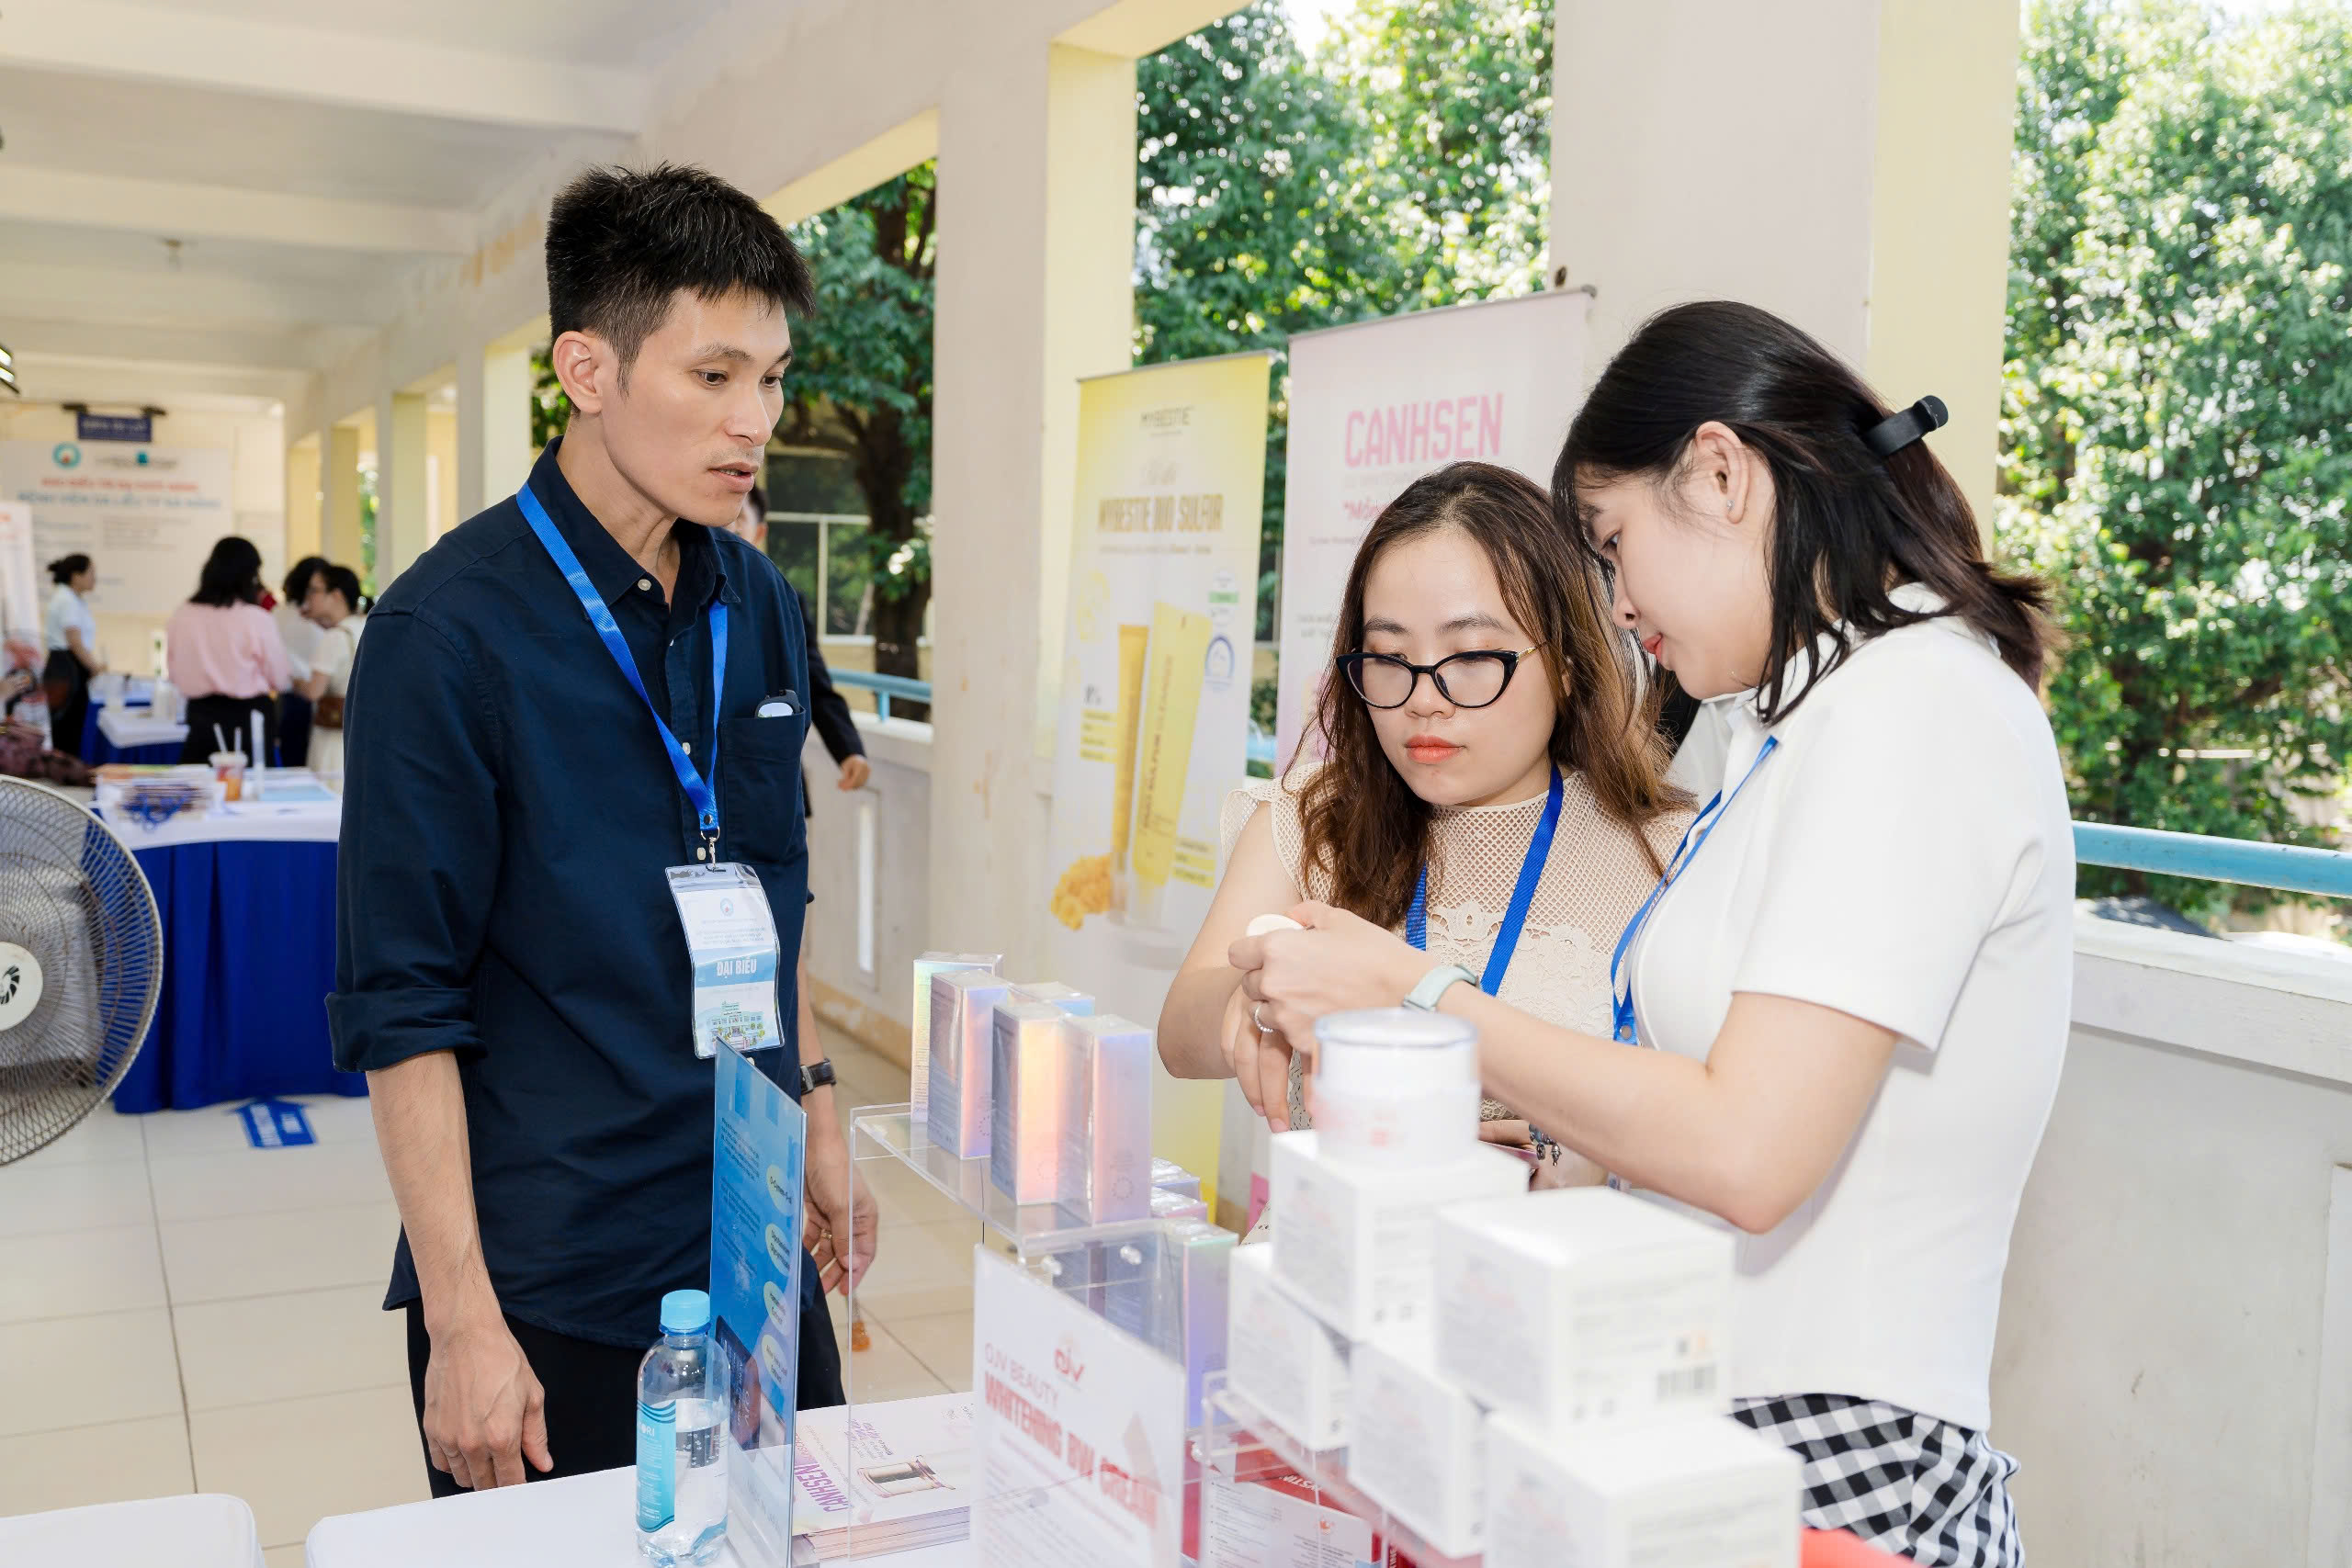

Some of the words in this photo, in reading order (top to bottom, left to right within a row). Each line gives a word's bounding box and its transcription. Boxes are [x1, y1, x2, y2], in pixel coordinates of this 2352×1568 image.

[1344, 391, 1504, 468] CANHSEN
[717, 961, 733, 978] ĐẠI
[735, 956, 757, 975] BIỂU
[985, 1370, 1063, 1461] WHITENING
[1098, 1456, 1158, 1531] CREAM
